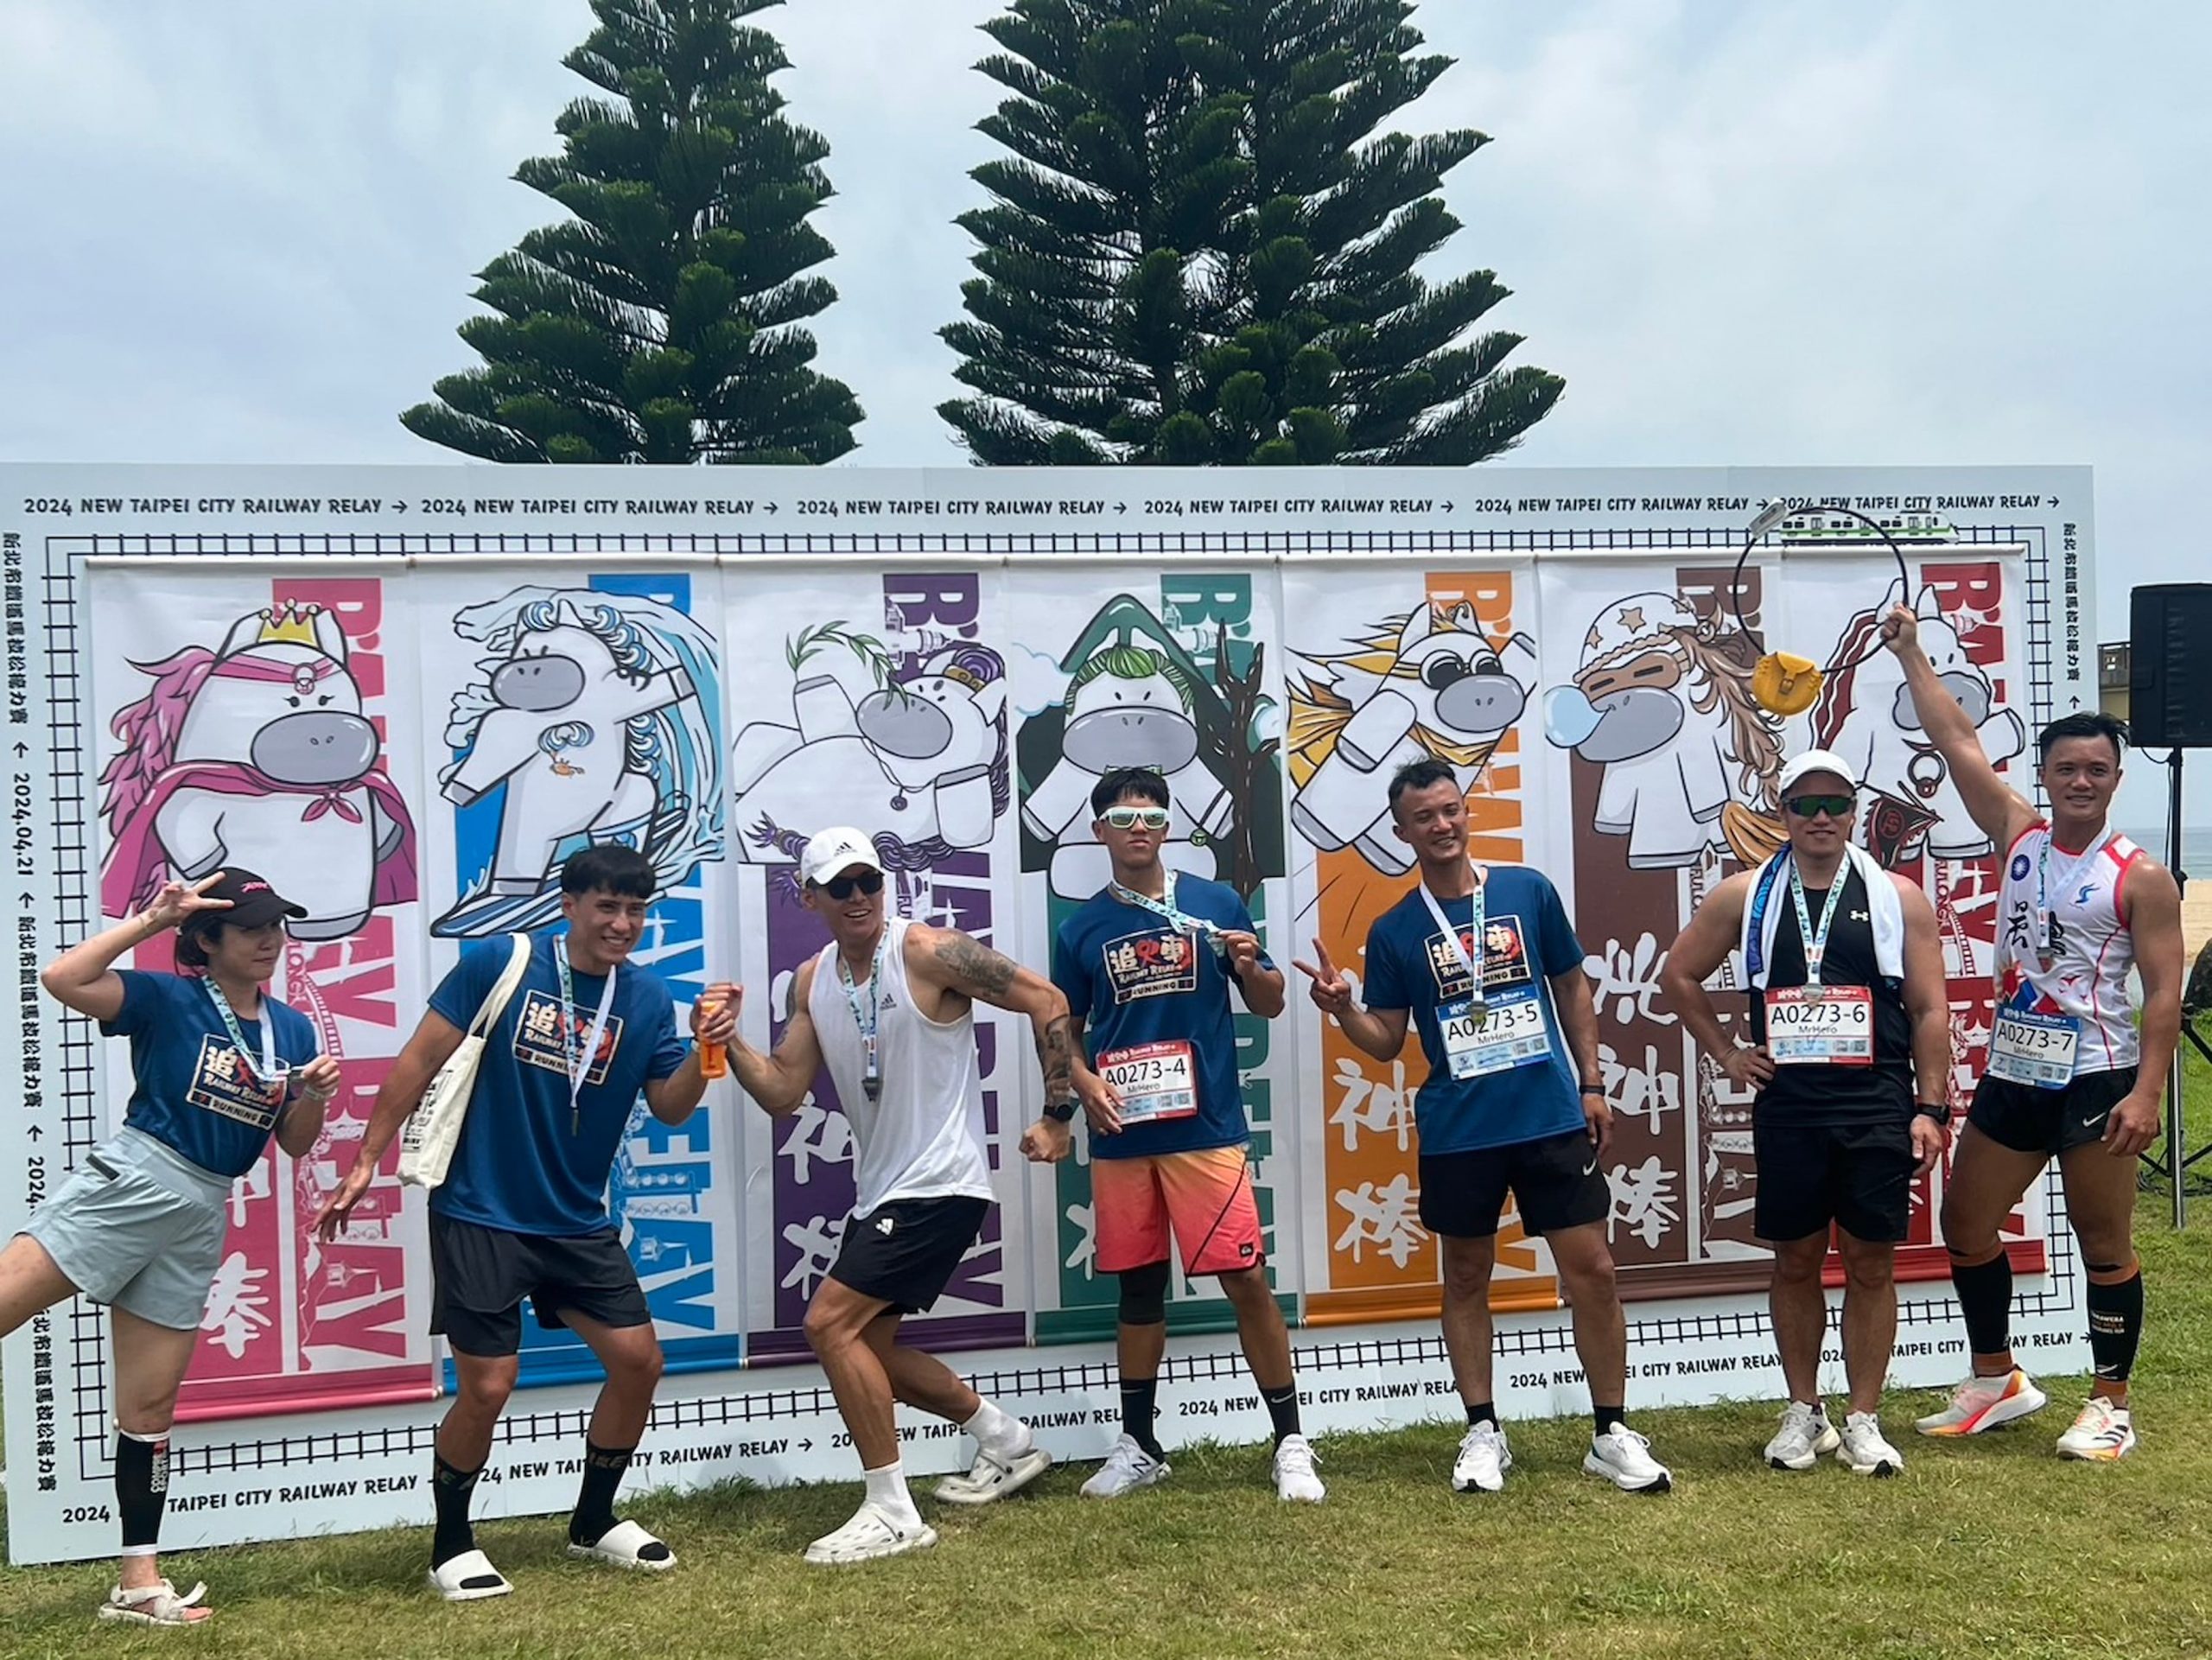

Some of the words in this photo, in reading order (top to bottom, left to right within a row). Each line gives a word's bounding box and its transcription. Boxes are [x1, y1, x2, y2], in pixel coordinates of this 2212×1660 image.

[25, 499, 72, 516] 2024
[81, 499, 123, 512] NEW
[130, 499, 188, 512] TAIPEI
[199, 499, 235, 512] CITY
[243, 499, 321, 513] RAILWAY
[328, 499, 381, 513] RELAY
[422, 499, 466, 516] 2024
[474, 499, 513, 512] NEW
[521, 500, 575, 513] TAIPEI
[584, 500, 618, 513] CITY
[626, 500, 697, 514] RAILWAY
[705, 501, 753, 514] RELAY
[798, 501, 837, 517] 2024
[847, 501, 881, 513] NEW
[888, 501, 939, 513] TAIPEI
[948, 501, 978, 513] CITY
[986, 501, 1052, 515] RAILWAY
[1059, 501, 1103, 515] RELAY
[1145, 501, 1182, 516] 2024
[1191, 500, 1224, 513] NEW
[1230, 500, 1277, 512] TAIPEI
[1285, 500, 1314, 512] CITY
[1321, 499, 1383, 512] RAILWAY
[1390, 500, 1432, 512] RELAY
[1476, 499, 1511, 514] 2024
[1519, 499, 1550, 511] NEW
[1556, 499, 1600, 511] TAIPEI
[1608, 499, 1636, 511] CITY
[1642, 499, 1701, 511] RAILWAY
[1707, 498, 1748, 511] RELAY
[1820, 497, 1850, 509] NEW
[1855, 497, 1898, 509] TAIPEI
[1904, 497, 1931, 509] CITY
[1937, 496, 1994, 509] RAILWAY
[2000, 496, 2039, 508] RELAY
[12, 773, 34, 875] 2024.04.21
[1459, 970, 1508, 989] RUNING
[1448, 1003, 1537, 1040] A0273-5
[1771, 1004, 1866, 1025] A0273-6
[1478, 1031, 1515, 1045] MrHero
[1799, 1026, 1838, 1034] MrHero
[1997, 1022, 2074, 1052] A0273-7
[1106, 1058, 1186, 1086] A0273-4
[1938, 1338, 1965, 1353] CITY
[2033, 1332, 2073, 1348] RELAY
[1510, 1374, 1548, 1390] 2024
[1554, 1370, 1587, 1384] NEW
[1643, 1362, 1671, 1377] CITY
[1677, 1358, 1737, 1375] RAILWAY
[1743, 1353, 1783, 1369] RELAY
[1179, 1400, 1219, 1417] 2024
[1224, 1396, 1259, 1412] NEW
[1320, 1388, 1350, 1403] CITY
[1356, 1383, 1419, 1402] RAILWAY
[1425, 1380, 1460, 1396] RELA
[831, 1433, 856, 1448] 20
[896, 1427, 917, 1442] EW
[924, 1422, 969, 1440] TAIPE
[1019, 1410, 1087, 1430] RAILWAY
[1093, 1408, 1122, 1424] REL
[480, 1468, 503, 1485] 24
[510, 1462, 549, 1480] NEW
[556, 1459, 589, 1475] TAI
[629, 1452, 653, 1468] ITY
[660, 1444, 733, 1466] RAILWAY
[739, 1438, 789, 1458] RELAY
[62, 1504, 111, 1523] 2024
[168, 1493, 227, 1513] TAIPEI
[235, 1488, 272, 1507] CITY
[279, 1480, 358, 1503] RAILWAY
[365, 1475, 418, 1494] RELAY
